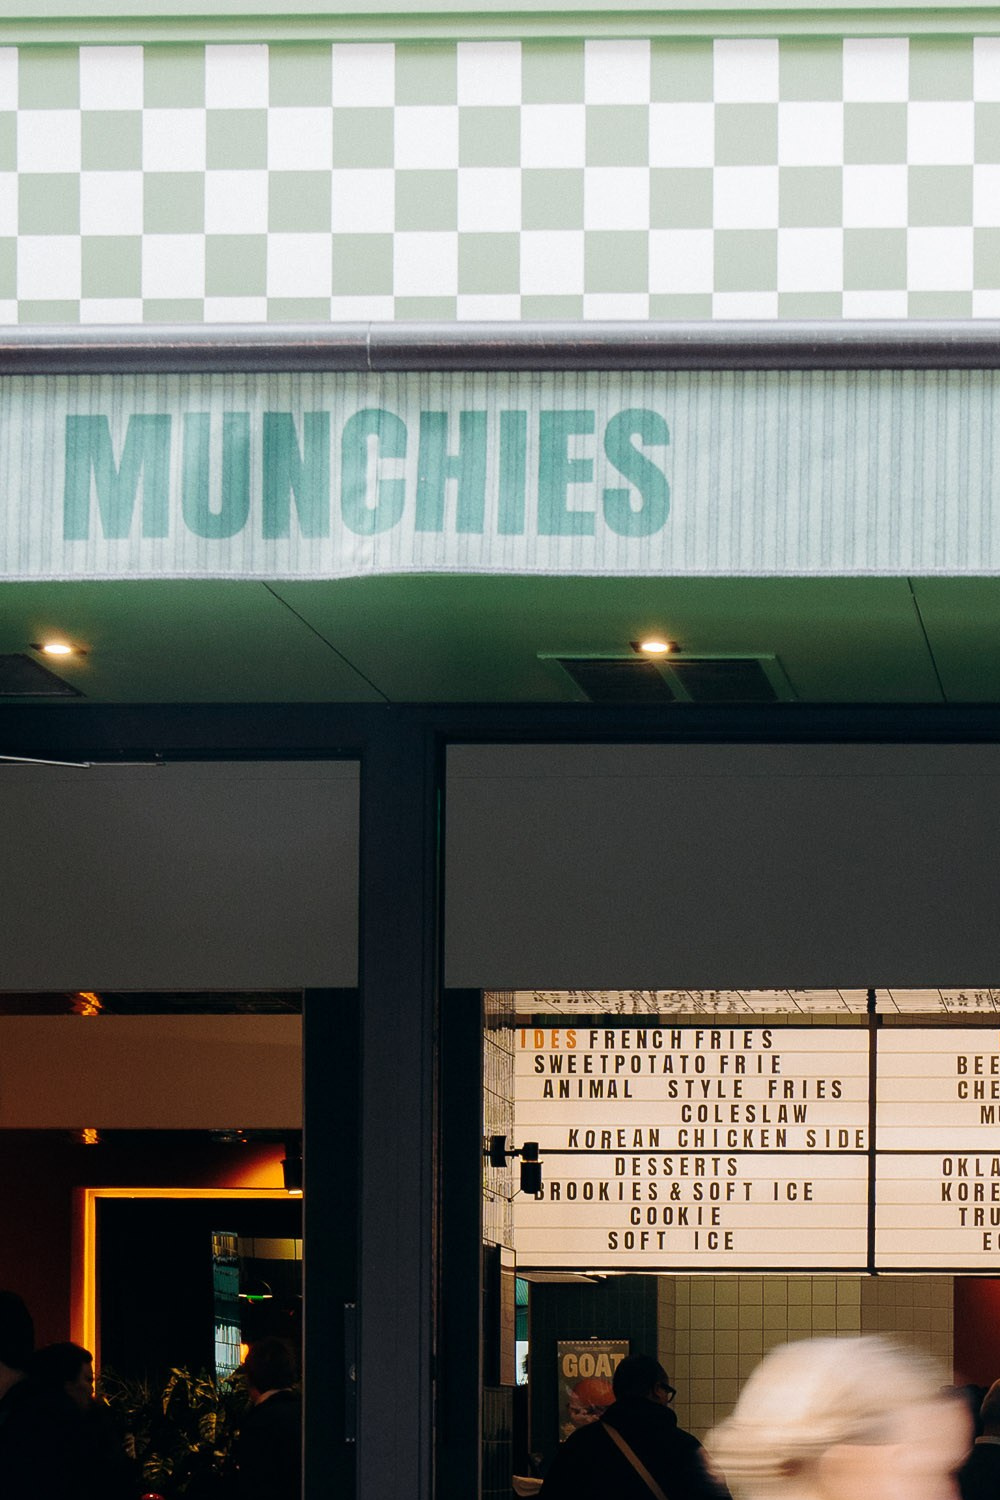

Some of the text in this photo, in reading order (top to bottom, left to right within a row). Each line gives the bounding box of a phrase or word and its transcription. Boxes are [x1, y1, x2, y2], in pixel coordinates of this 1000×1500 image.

[63, 407, 672, 541] MUNCHIES
[520, 1029, 772, 1050] IDES FRENCH FRIES
[720, 1054, 780, 1074] FRIE
[543, 1078, 842, 1099] ANIMAL STYLE FRIES
[681, 1104, 807, 1124] COLESLAW
[568, 1128, 864, 1149] KOREAN CHICKEN SIDE
[615, 1157, 737, 1177] DESSERTS
[670, 1182, 681, 1201] &
[693, 1182, 750, 1201] SOFT
[774, 1181, 813, 1201] ICE
[630, 1206, 720, 1226] COOKIE
[608, 1231, 733, 1250] SOFT ICE
[562, 1353, 625, 1378] GOAT
